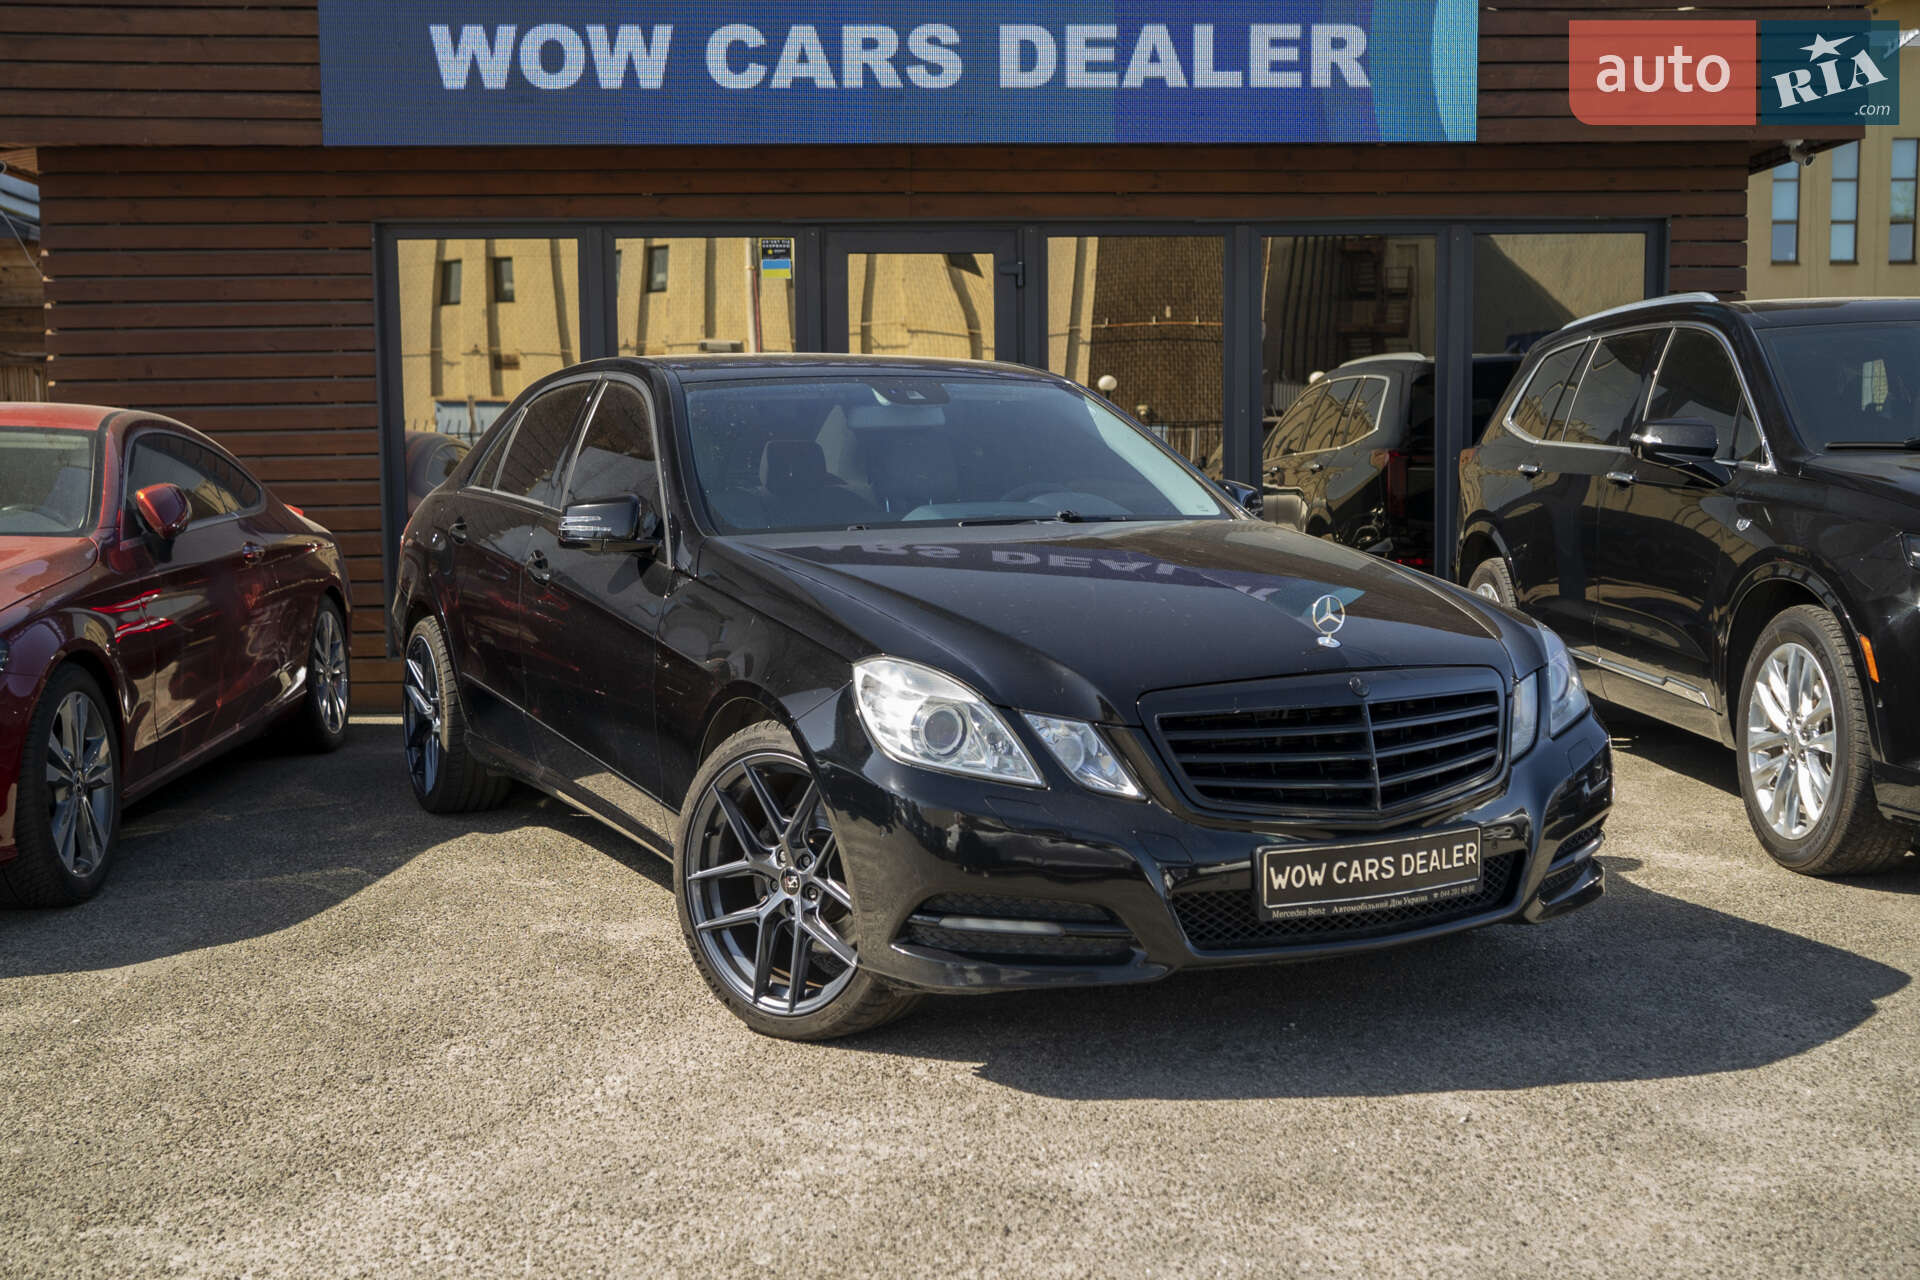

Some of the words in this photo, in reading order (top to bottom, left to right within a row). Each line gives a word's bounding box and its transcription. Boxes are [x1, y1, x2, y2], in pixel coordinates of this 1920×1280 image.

[428, 23, 674, 90] WOW
[705, 23, 962, 90] CARS
[999, 23, 1371, 89] DEALER
[1269, 862, 1327, 891] WOW
[1332, 856, 1396, 885] CARS
[1401, 842, 1478, 877] DEALER
